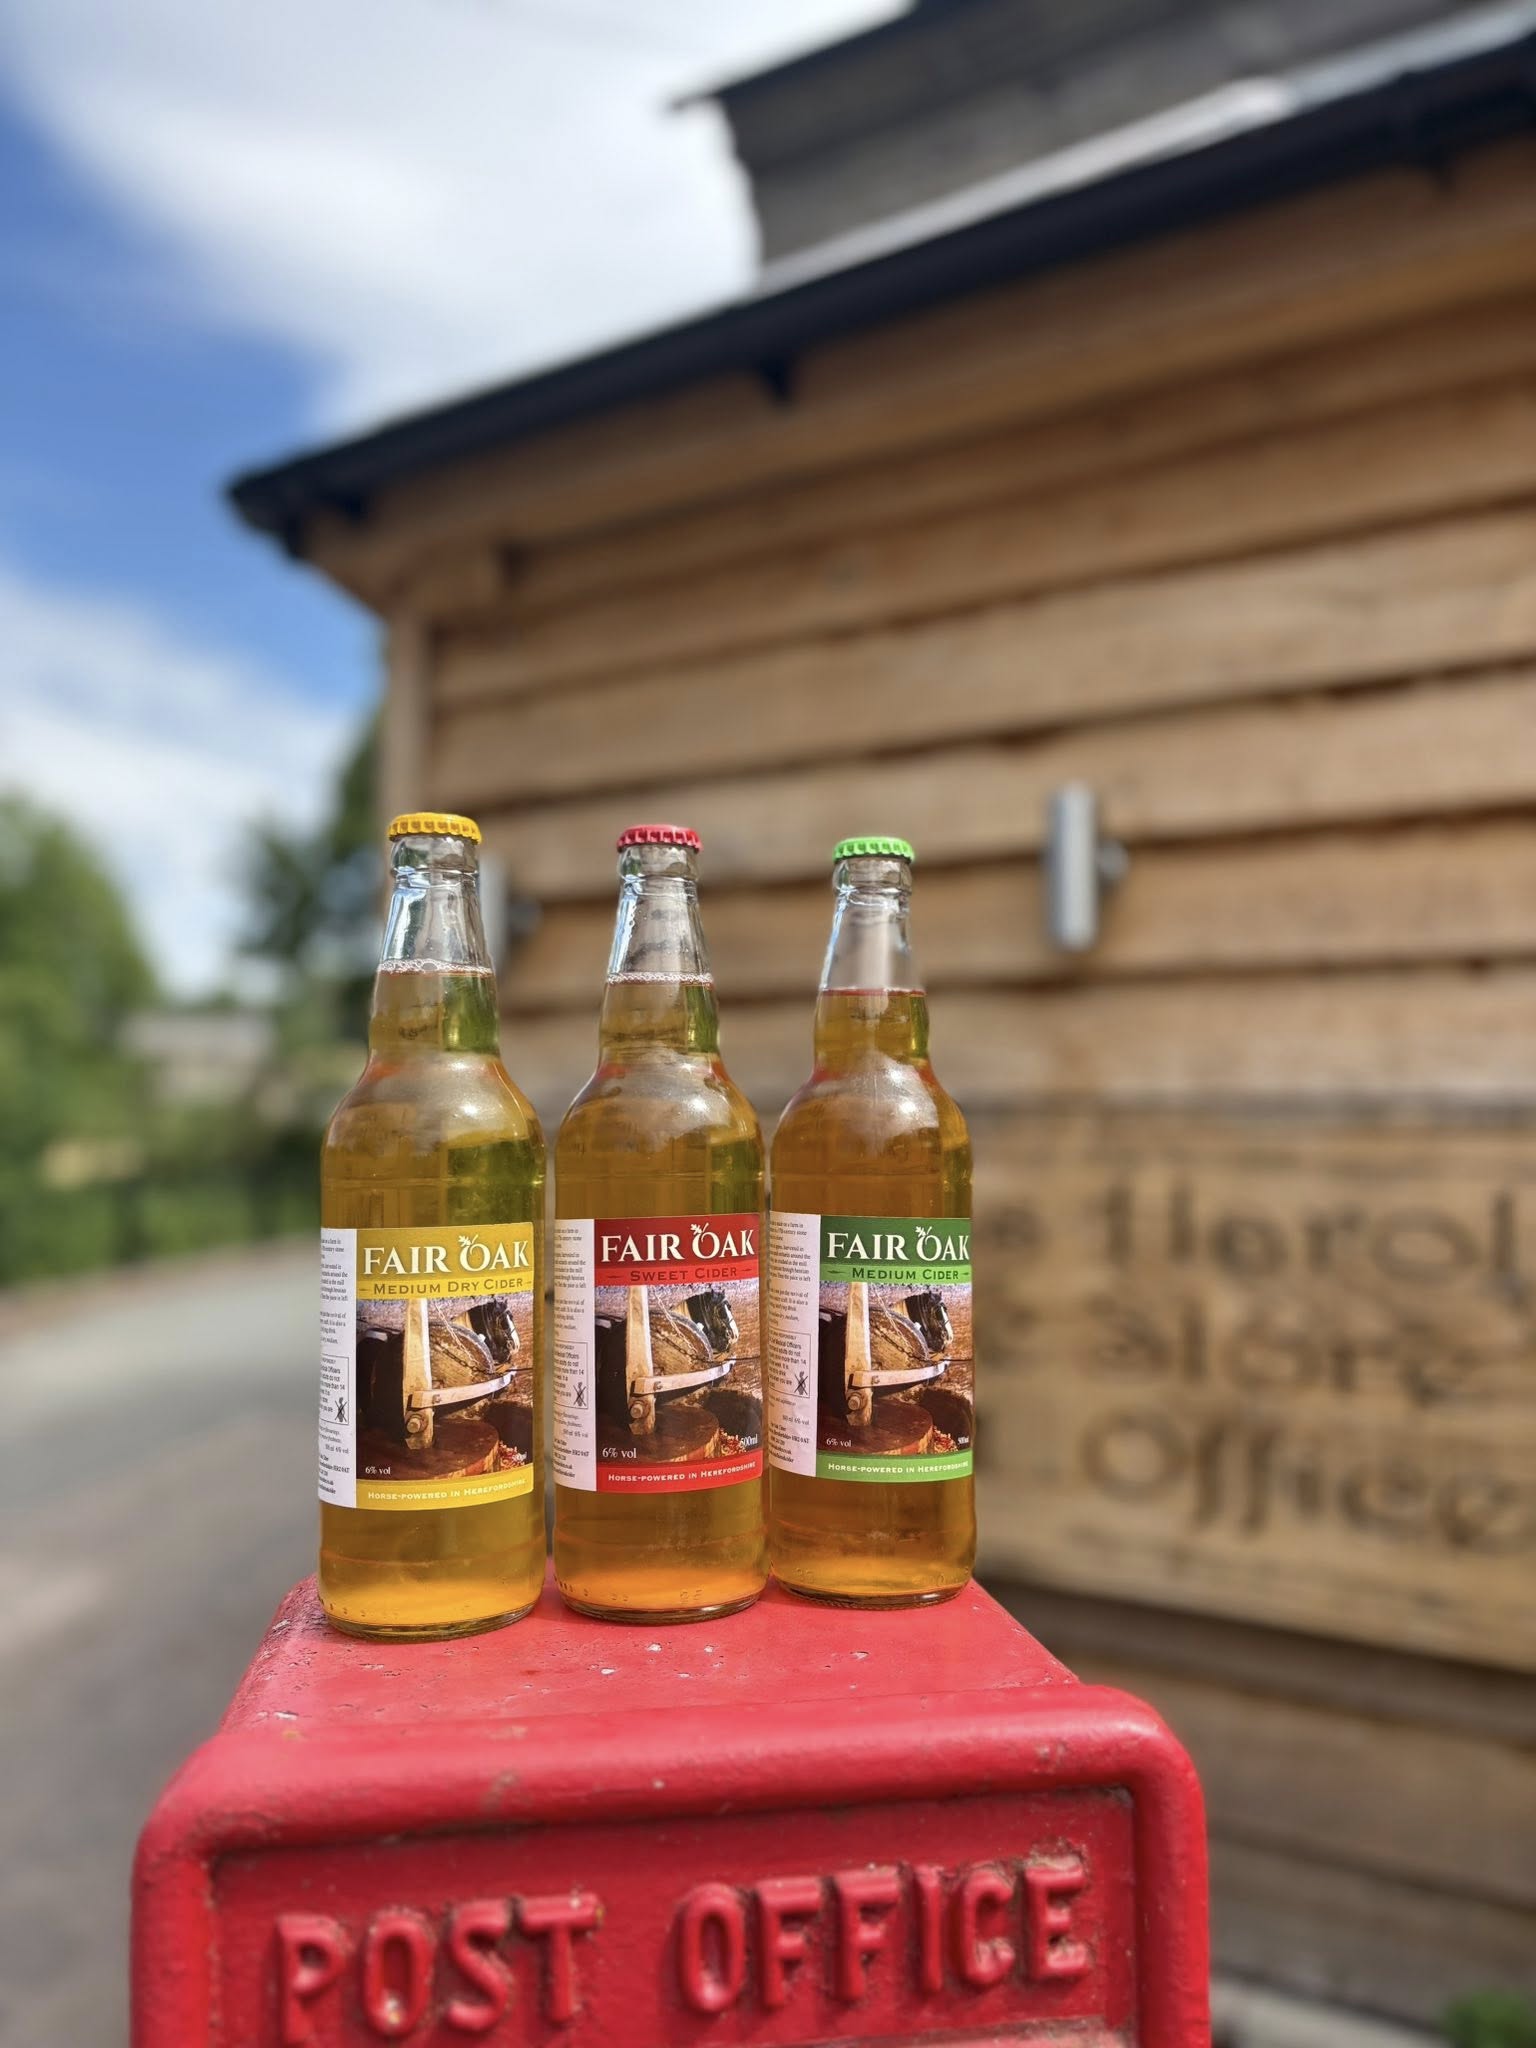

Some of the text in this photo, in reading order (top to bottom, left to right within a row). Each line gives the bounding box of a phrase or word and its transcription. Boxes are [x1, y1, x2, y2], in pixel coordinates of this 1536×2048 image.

[363, 1246, 451, 1275] FAIR
[459, 1239, 529, 1273] OAK
[601, 1233, 685, 1262] FAIR
[692, 1229, 755, 1260] OAK
[827, 1232, 970, 1261] FAIR OAK
[602, 1448, 637, 1458] 6% vol
[826, 1437, 852, 1448] 6% vol
[365, 1466, 391, 1475] 6% vol
[276, 1852, 1090, 2044] POST OFFICE
